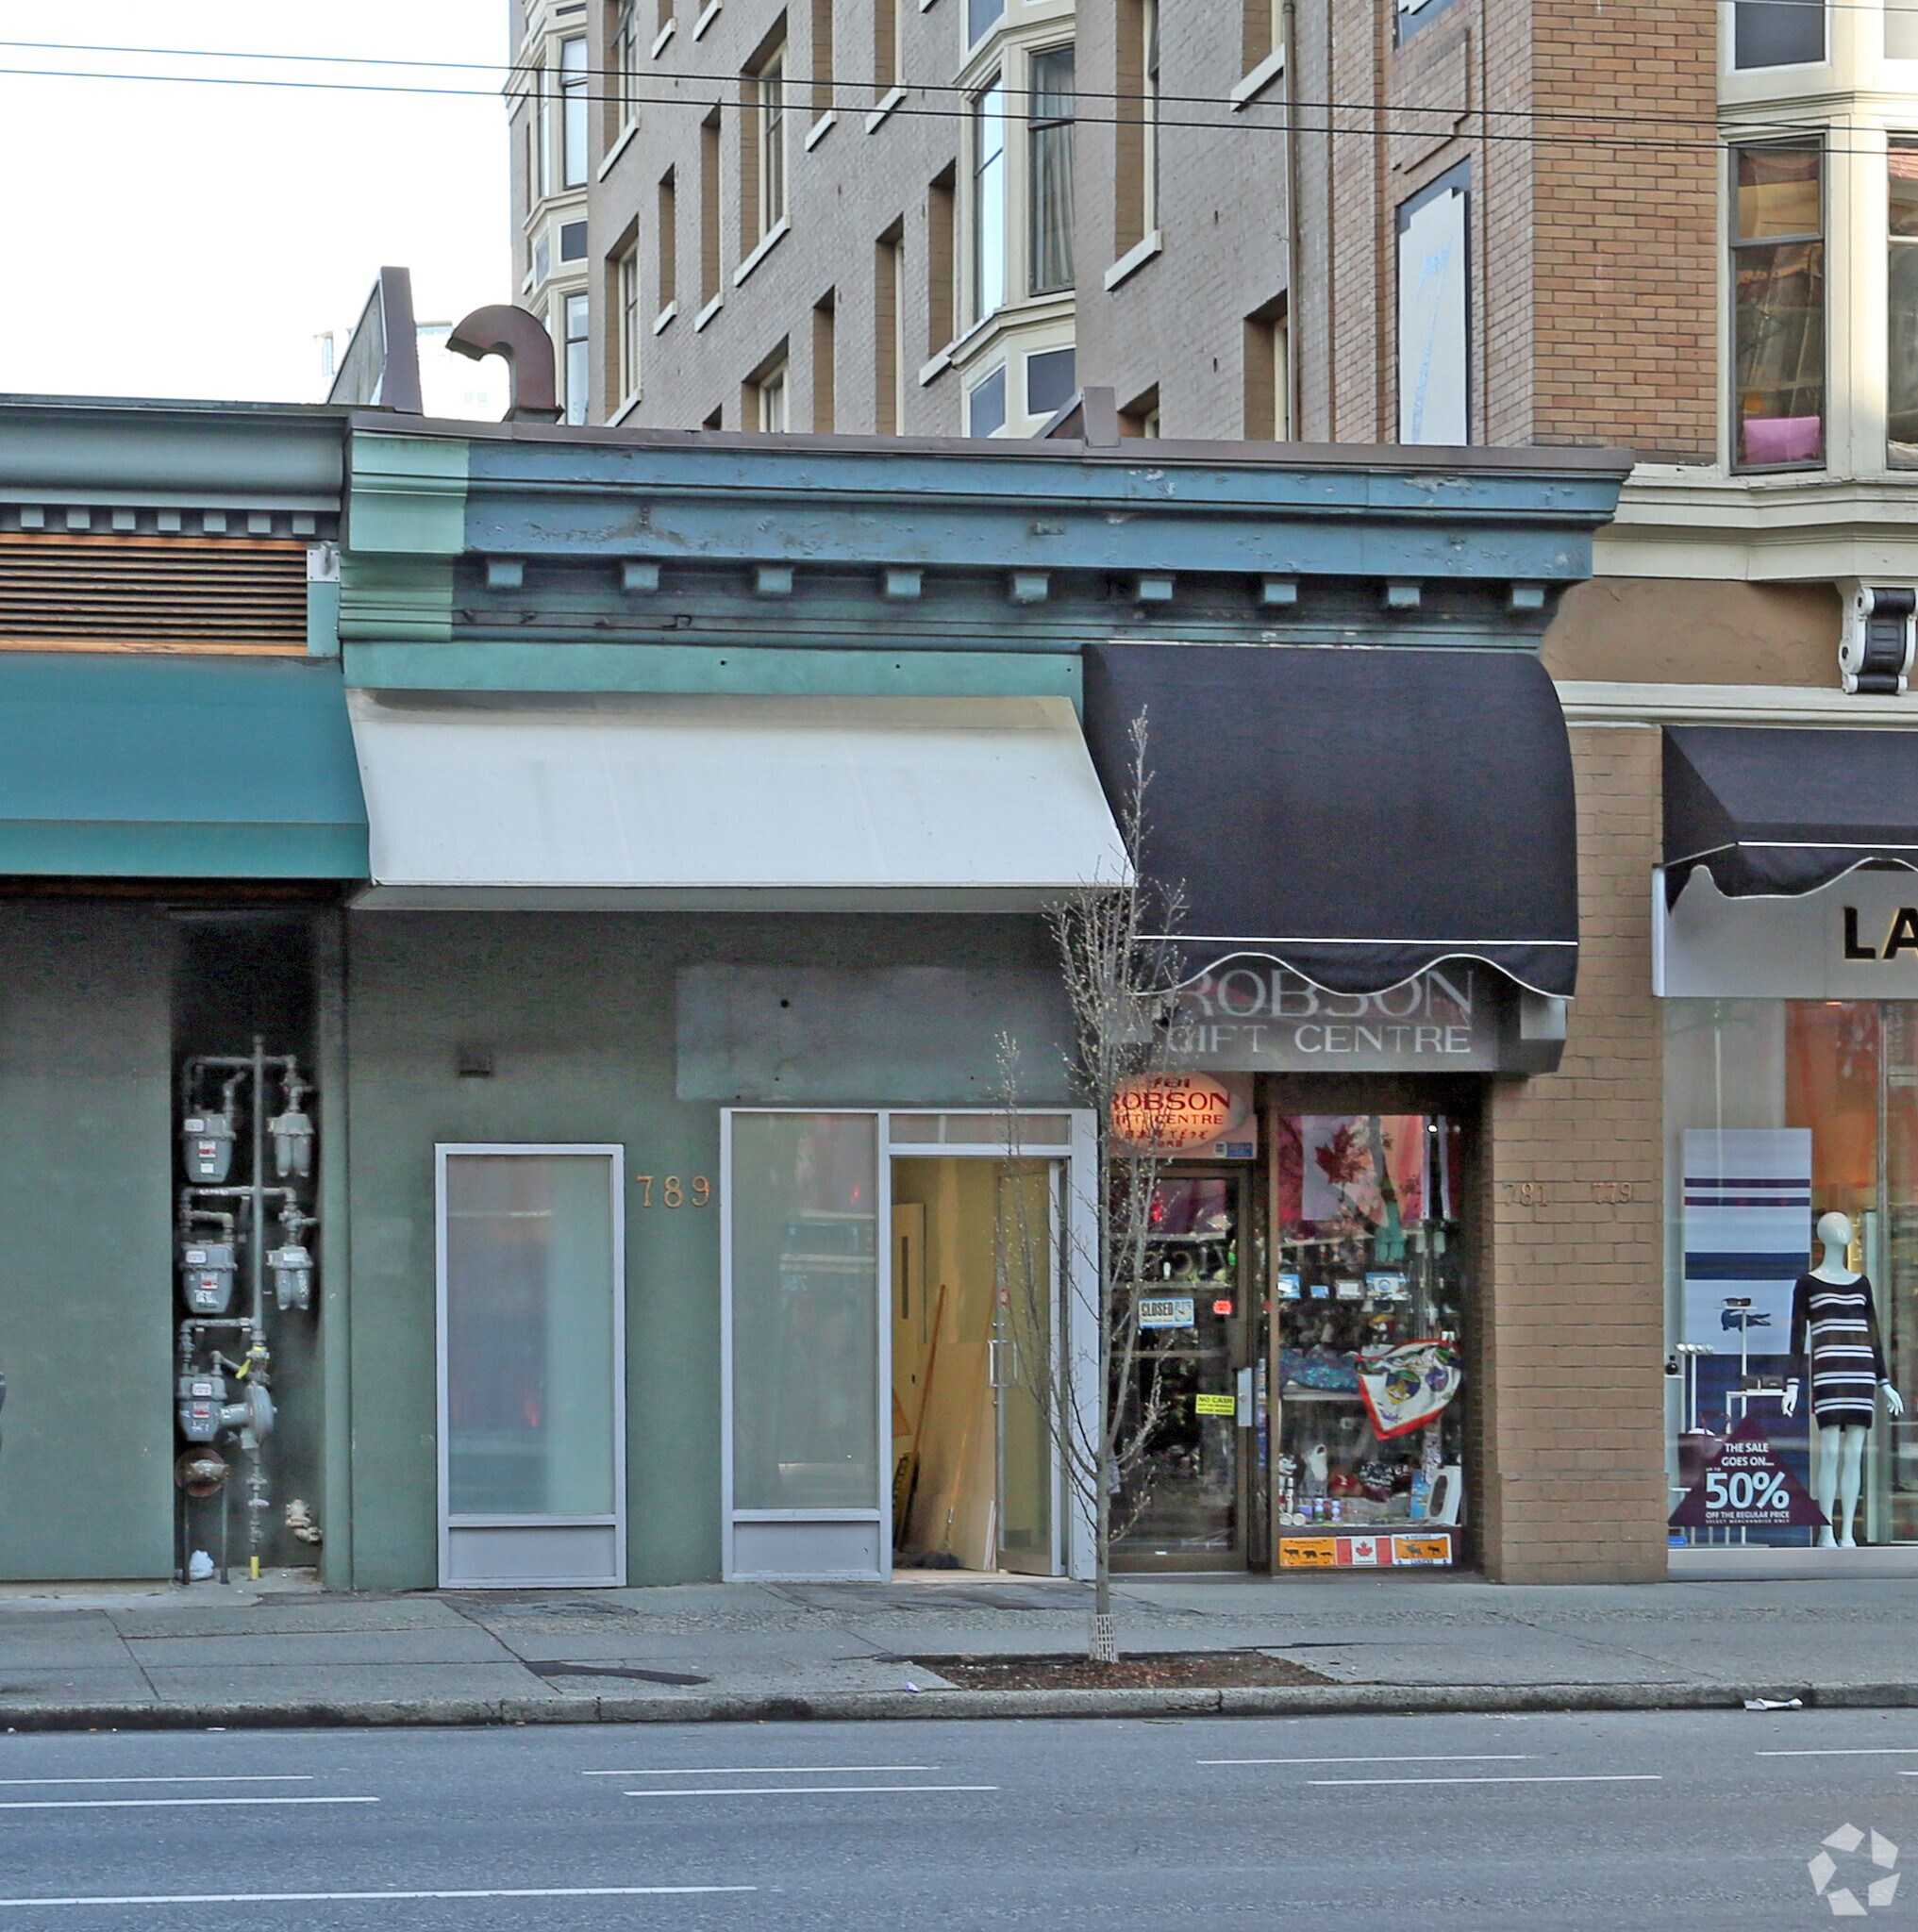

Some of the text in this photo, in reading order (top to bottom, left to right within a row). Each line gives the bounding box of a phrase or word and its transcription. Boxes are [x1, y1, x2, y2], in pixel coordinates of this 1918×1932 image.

[1167, 1024, 1471, 1054] GIFT CENTRE
[1155, 1113, 1225, 1125] CENTRE
[635, 1175, 710, 1208] 789
[1503, 1182, 1548, 1208] 781
[1592, 1182, 1632, 1205] 779
[1142, 1302, 1174, 1317] CLOSED
[1725, 1442, 1769, 1453] THE SALE
[1721, 1456, 1749, 1467] GOES
[1706, 1471, 1790, 1509] 50%
